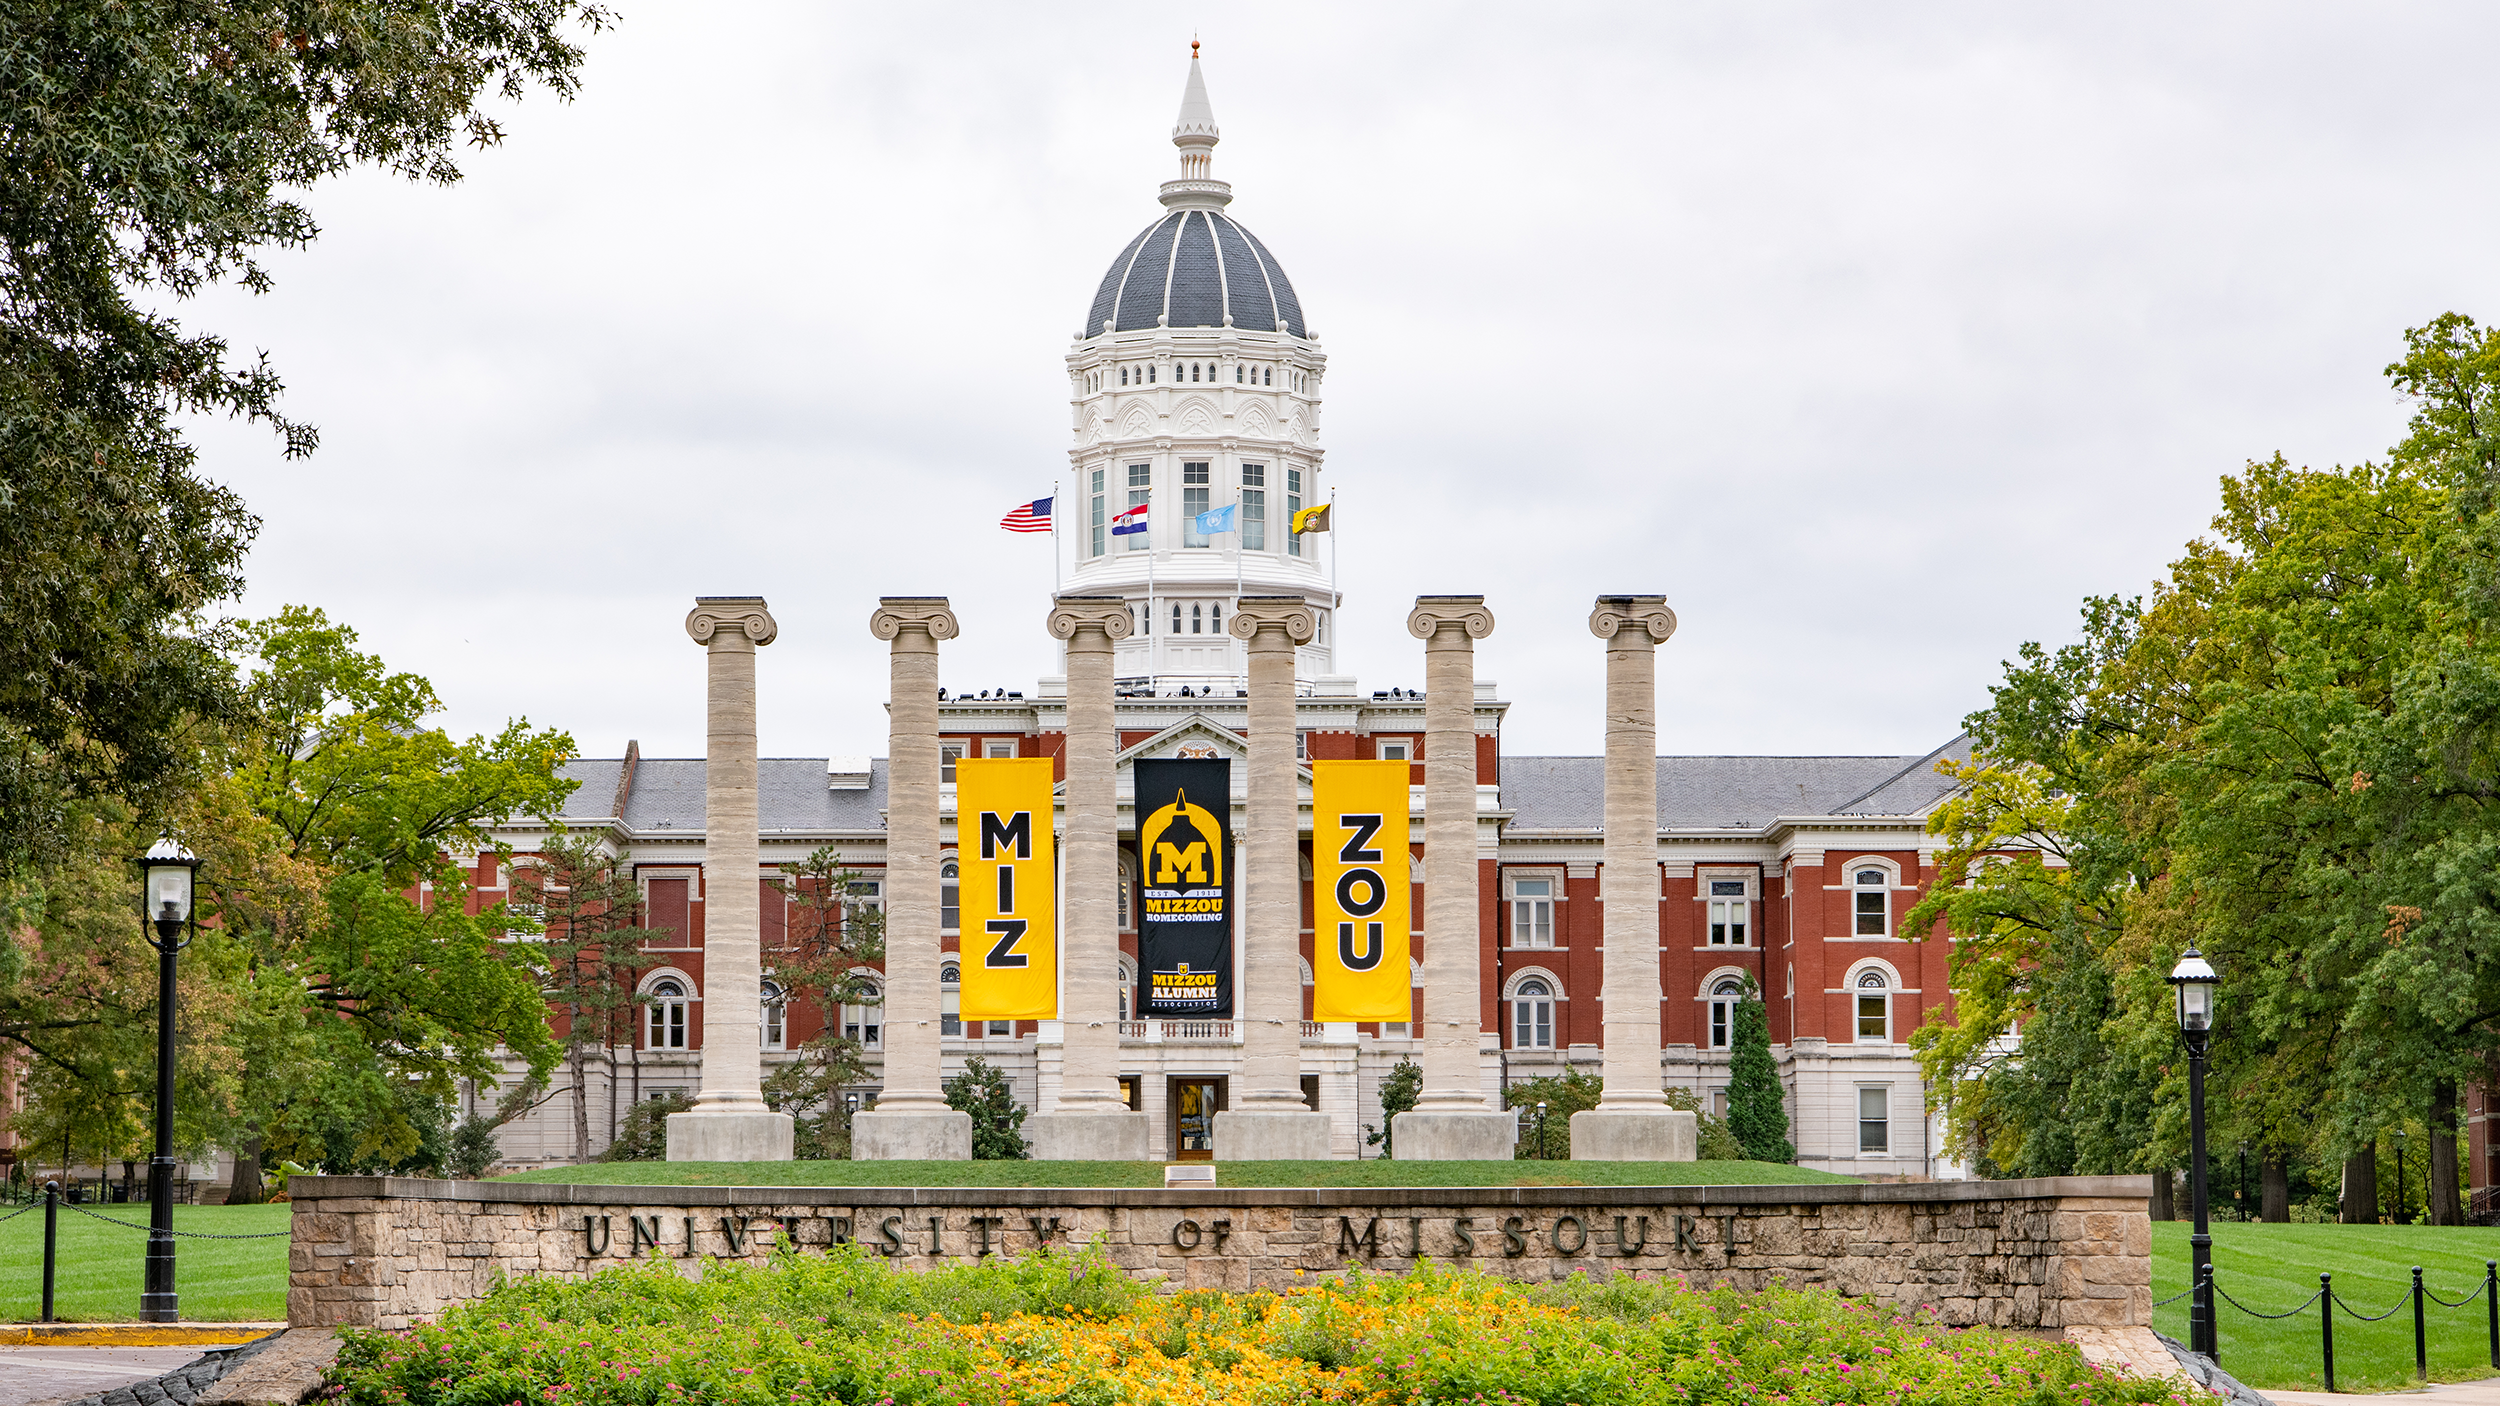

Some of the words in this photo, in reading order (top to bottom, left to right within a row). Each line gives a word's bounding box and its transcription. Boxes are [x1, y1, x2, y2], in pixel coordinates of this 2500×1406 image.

[1156, 841, 1207, 883] M
[980, 811, 1032, 969] MIZ
[1335, 813, 1387, 972] ZOU
[1145, 898, 1223, 913] MIZZOU
[1146, 913, 1222, 922] HOMECOMING
[1152, 974, 1216, 986] MIZZOU
[1152, 986, 1217, 998] ALUMNI
[585, 1215, 1060, 1256] UNIVERSITY
[1172, 1219, 1231, 1251] OF
[1340, 1215, 1738, 1255] MISSOURI
